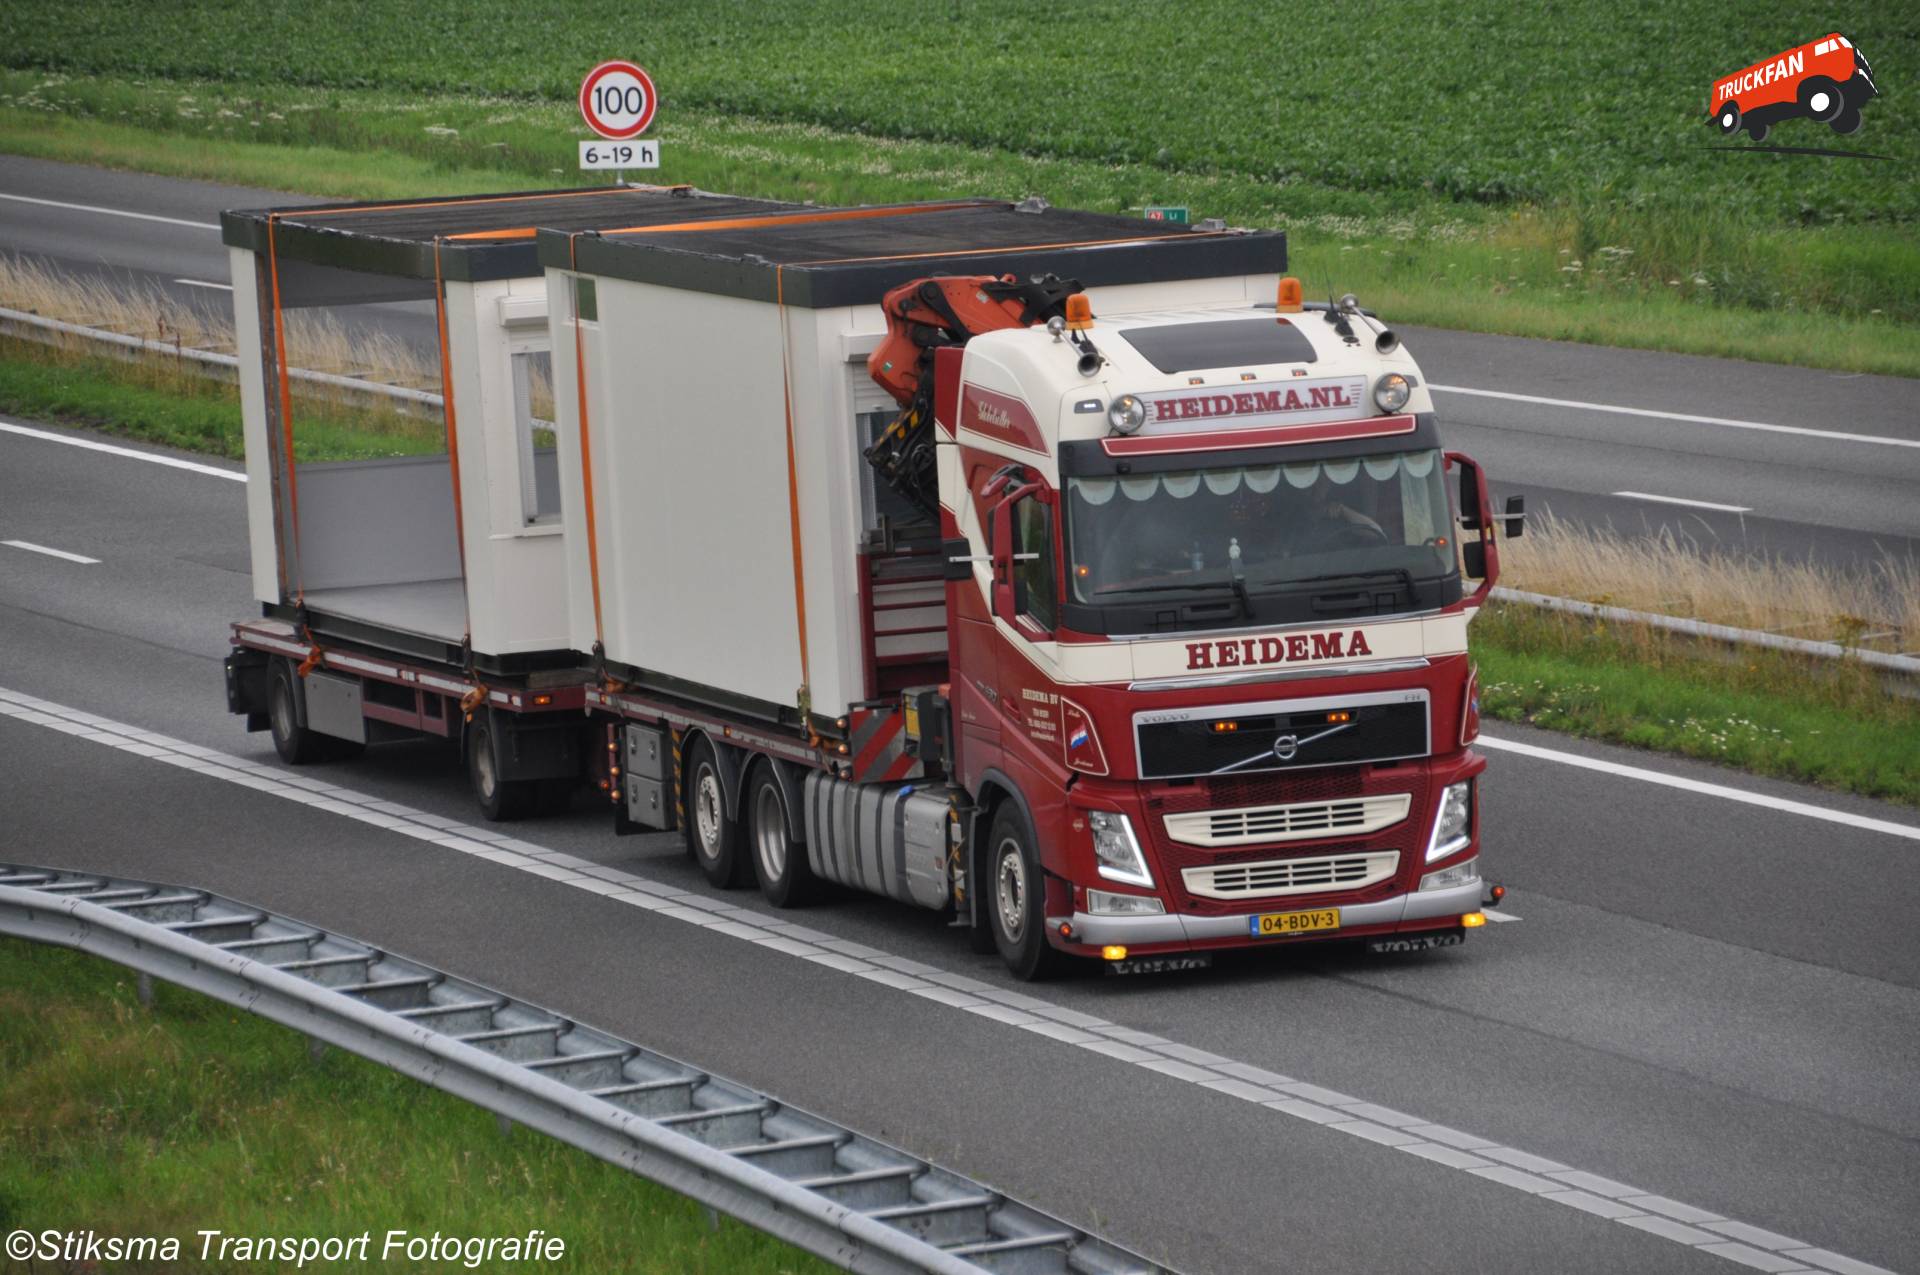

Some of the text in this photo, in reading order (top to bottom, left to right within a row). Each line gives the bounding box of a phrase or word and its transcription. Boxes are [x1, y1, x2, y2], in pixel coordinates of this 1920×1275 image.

[595, 86, 642, 115] 100
[585, 146, 653, 164] 6-19 h
[1154, 386, 1350, 421] HEIDEMA.NL
[1185, 630, 1372, 670] HEIDEMA
[1263, 912, 1334, 932] 04-BDV-3
